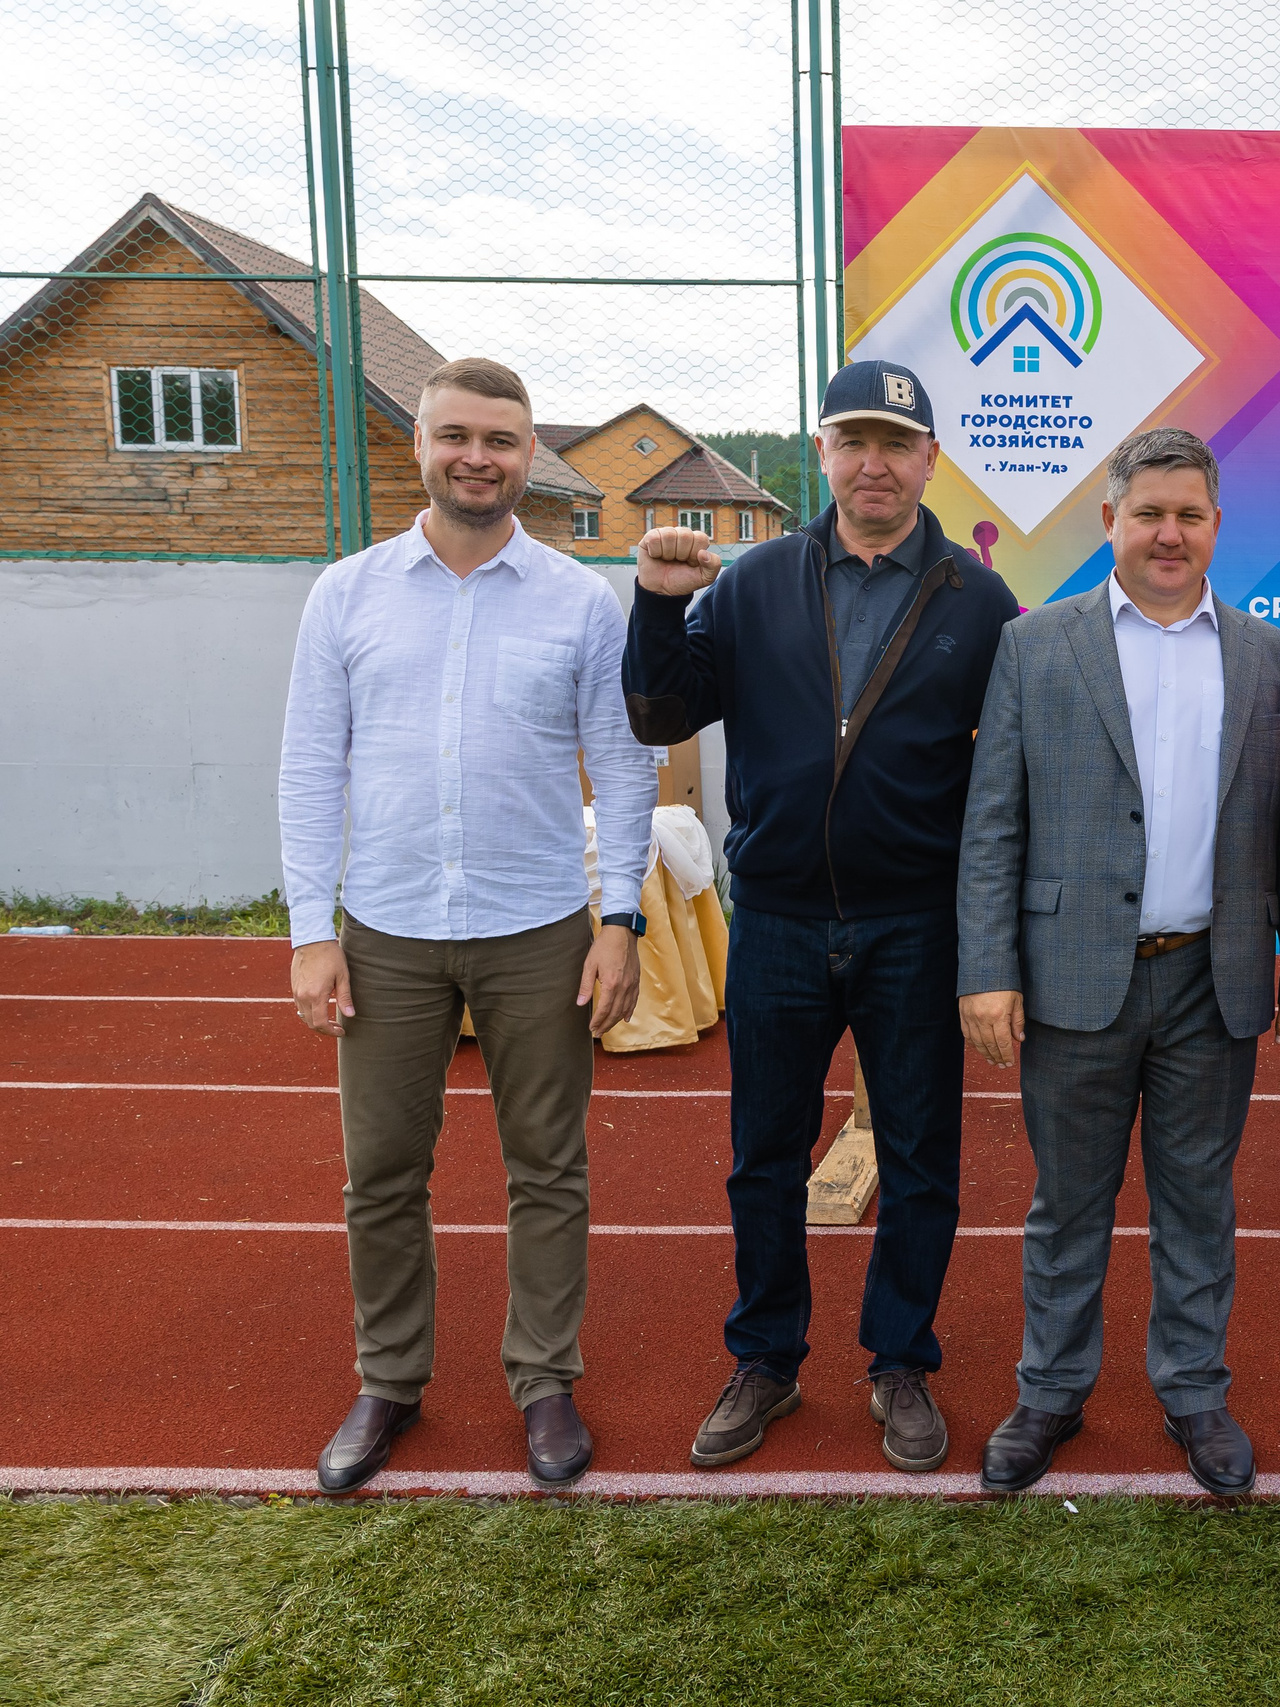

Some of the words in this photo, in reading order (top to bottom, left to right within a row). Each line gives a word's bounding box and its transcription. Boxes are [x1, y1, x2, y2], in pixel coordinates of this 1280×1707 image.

[981, 394, 1073, 408] КОМИТЕТ
[961, 413, 1093, 430] ГОРОДСКОГО
[969, 431, 1084, 449] ХОЗЯЙСТВА
[985, 463, 996, 472] г.
[998, 461, 1068, 474] Улан-Удэ
